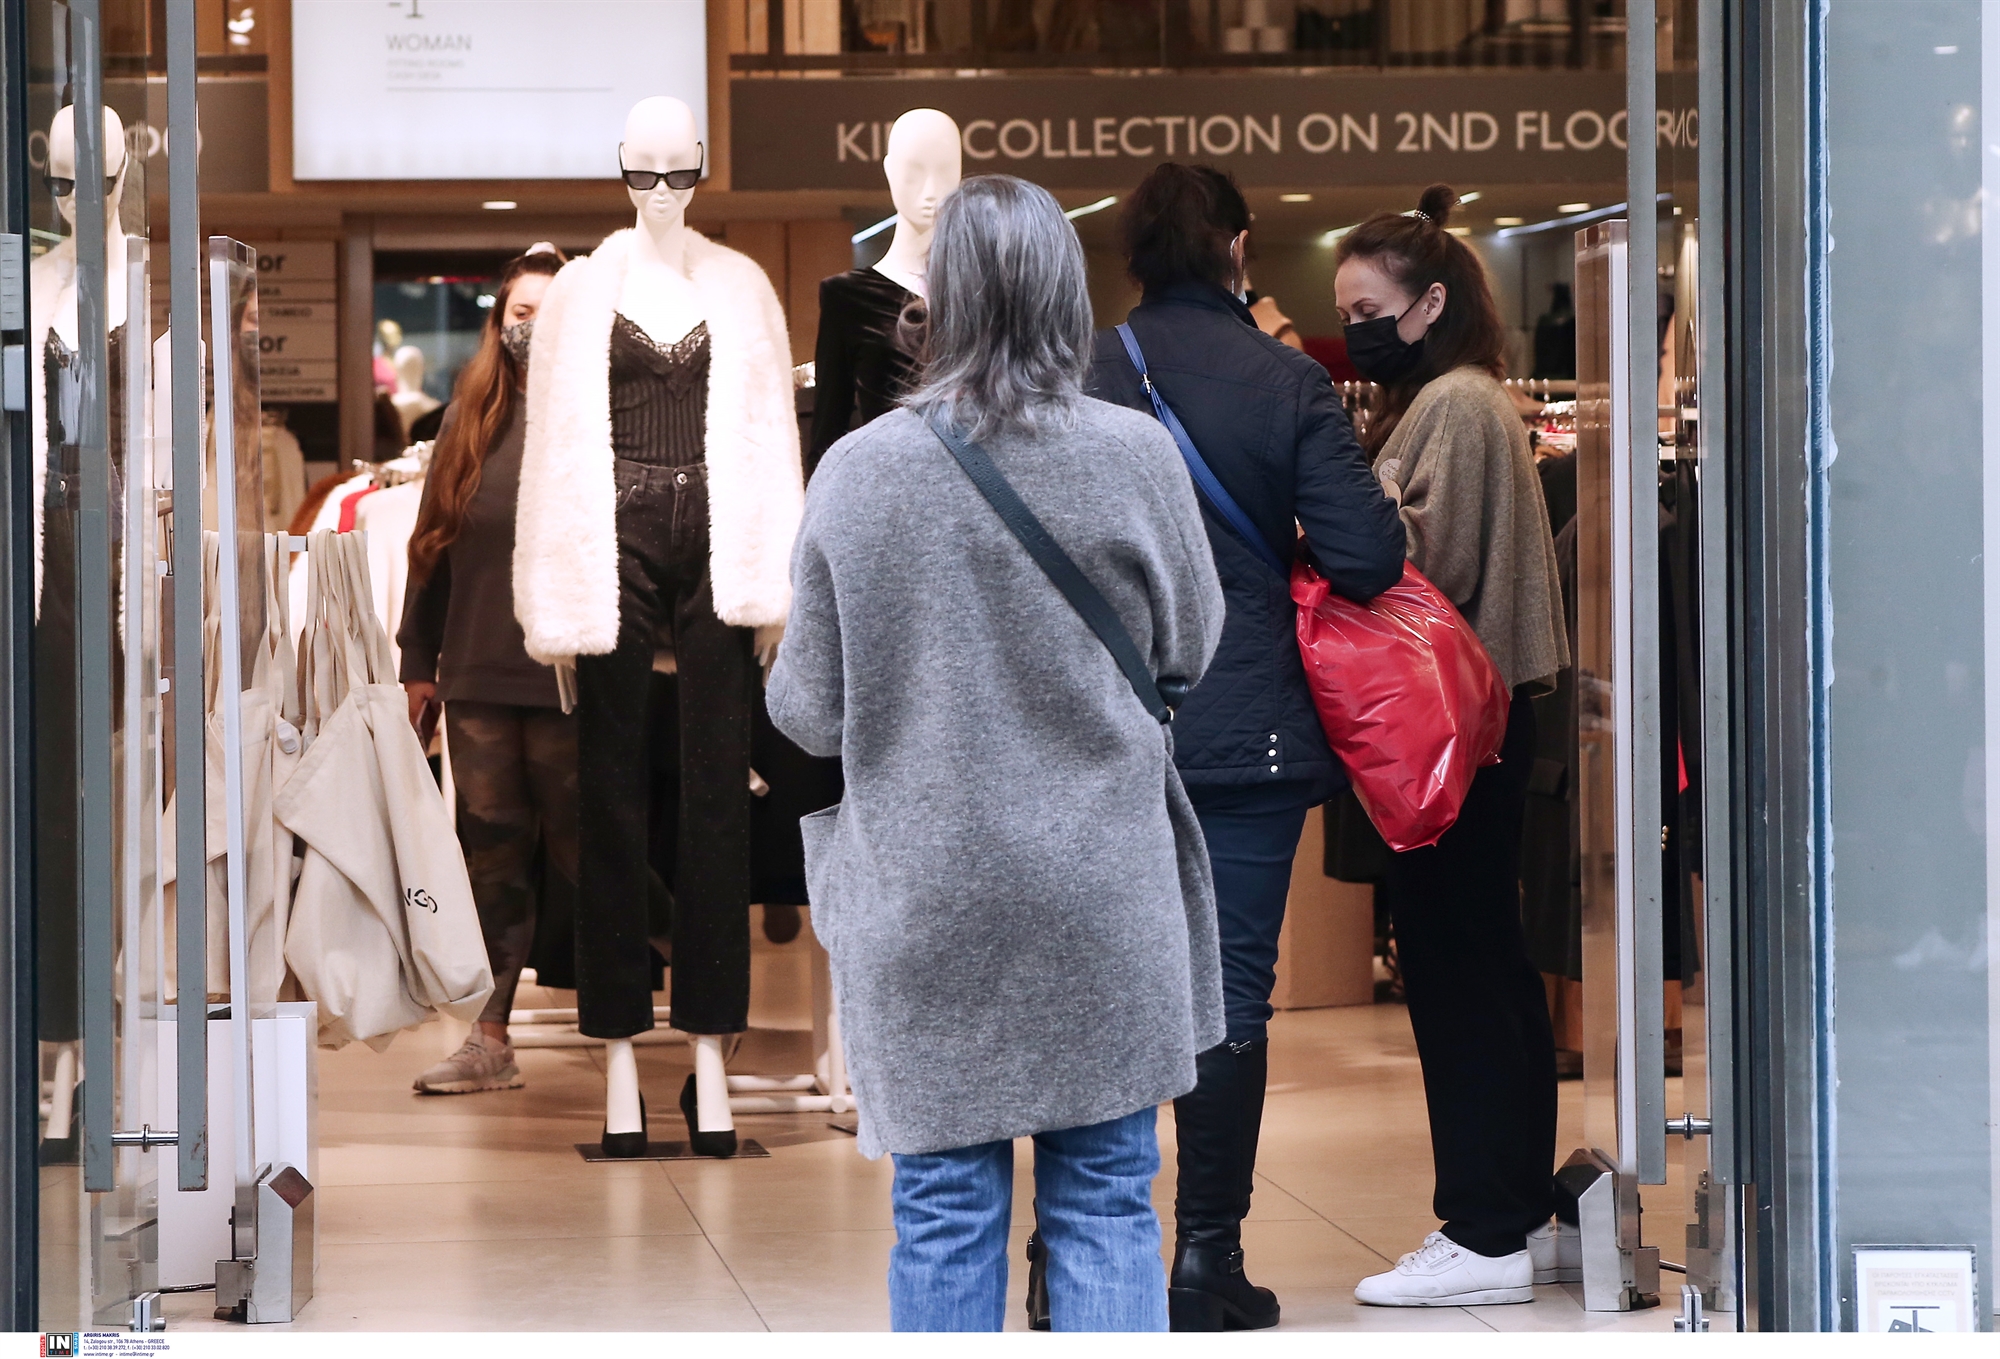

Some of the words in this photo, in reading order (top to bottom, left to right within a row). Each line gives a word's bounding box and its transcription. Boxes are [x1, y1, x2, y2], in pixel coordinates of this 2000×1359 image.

[385, 33, 473, 51] WOMAN
[962, 115, 1281, 160] COLLECTION
[1298, 111, 1379, 153] ON
[1394, 110, 1499, 153] 2ND
